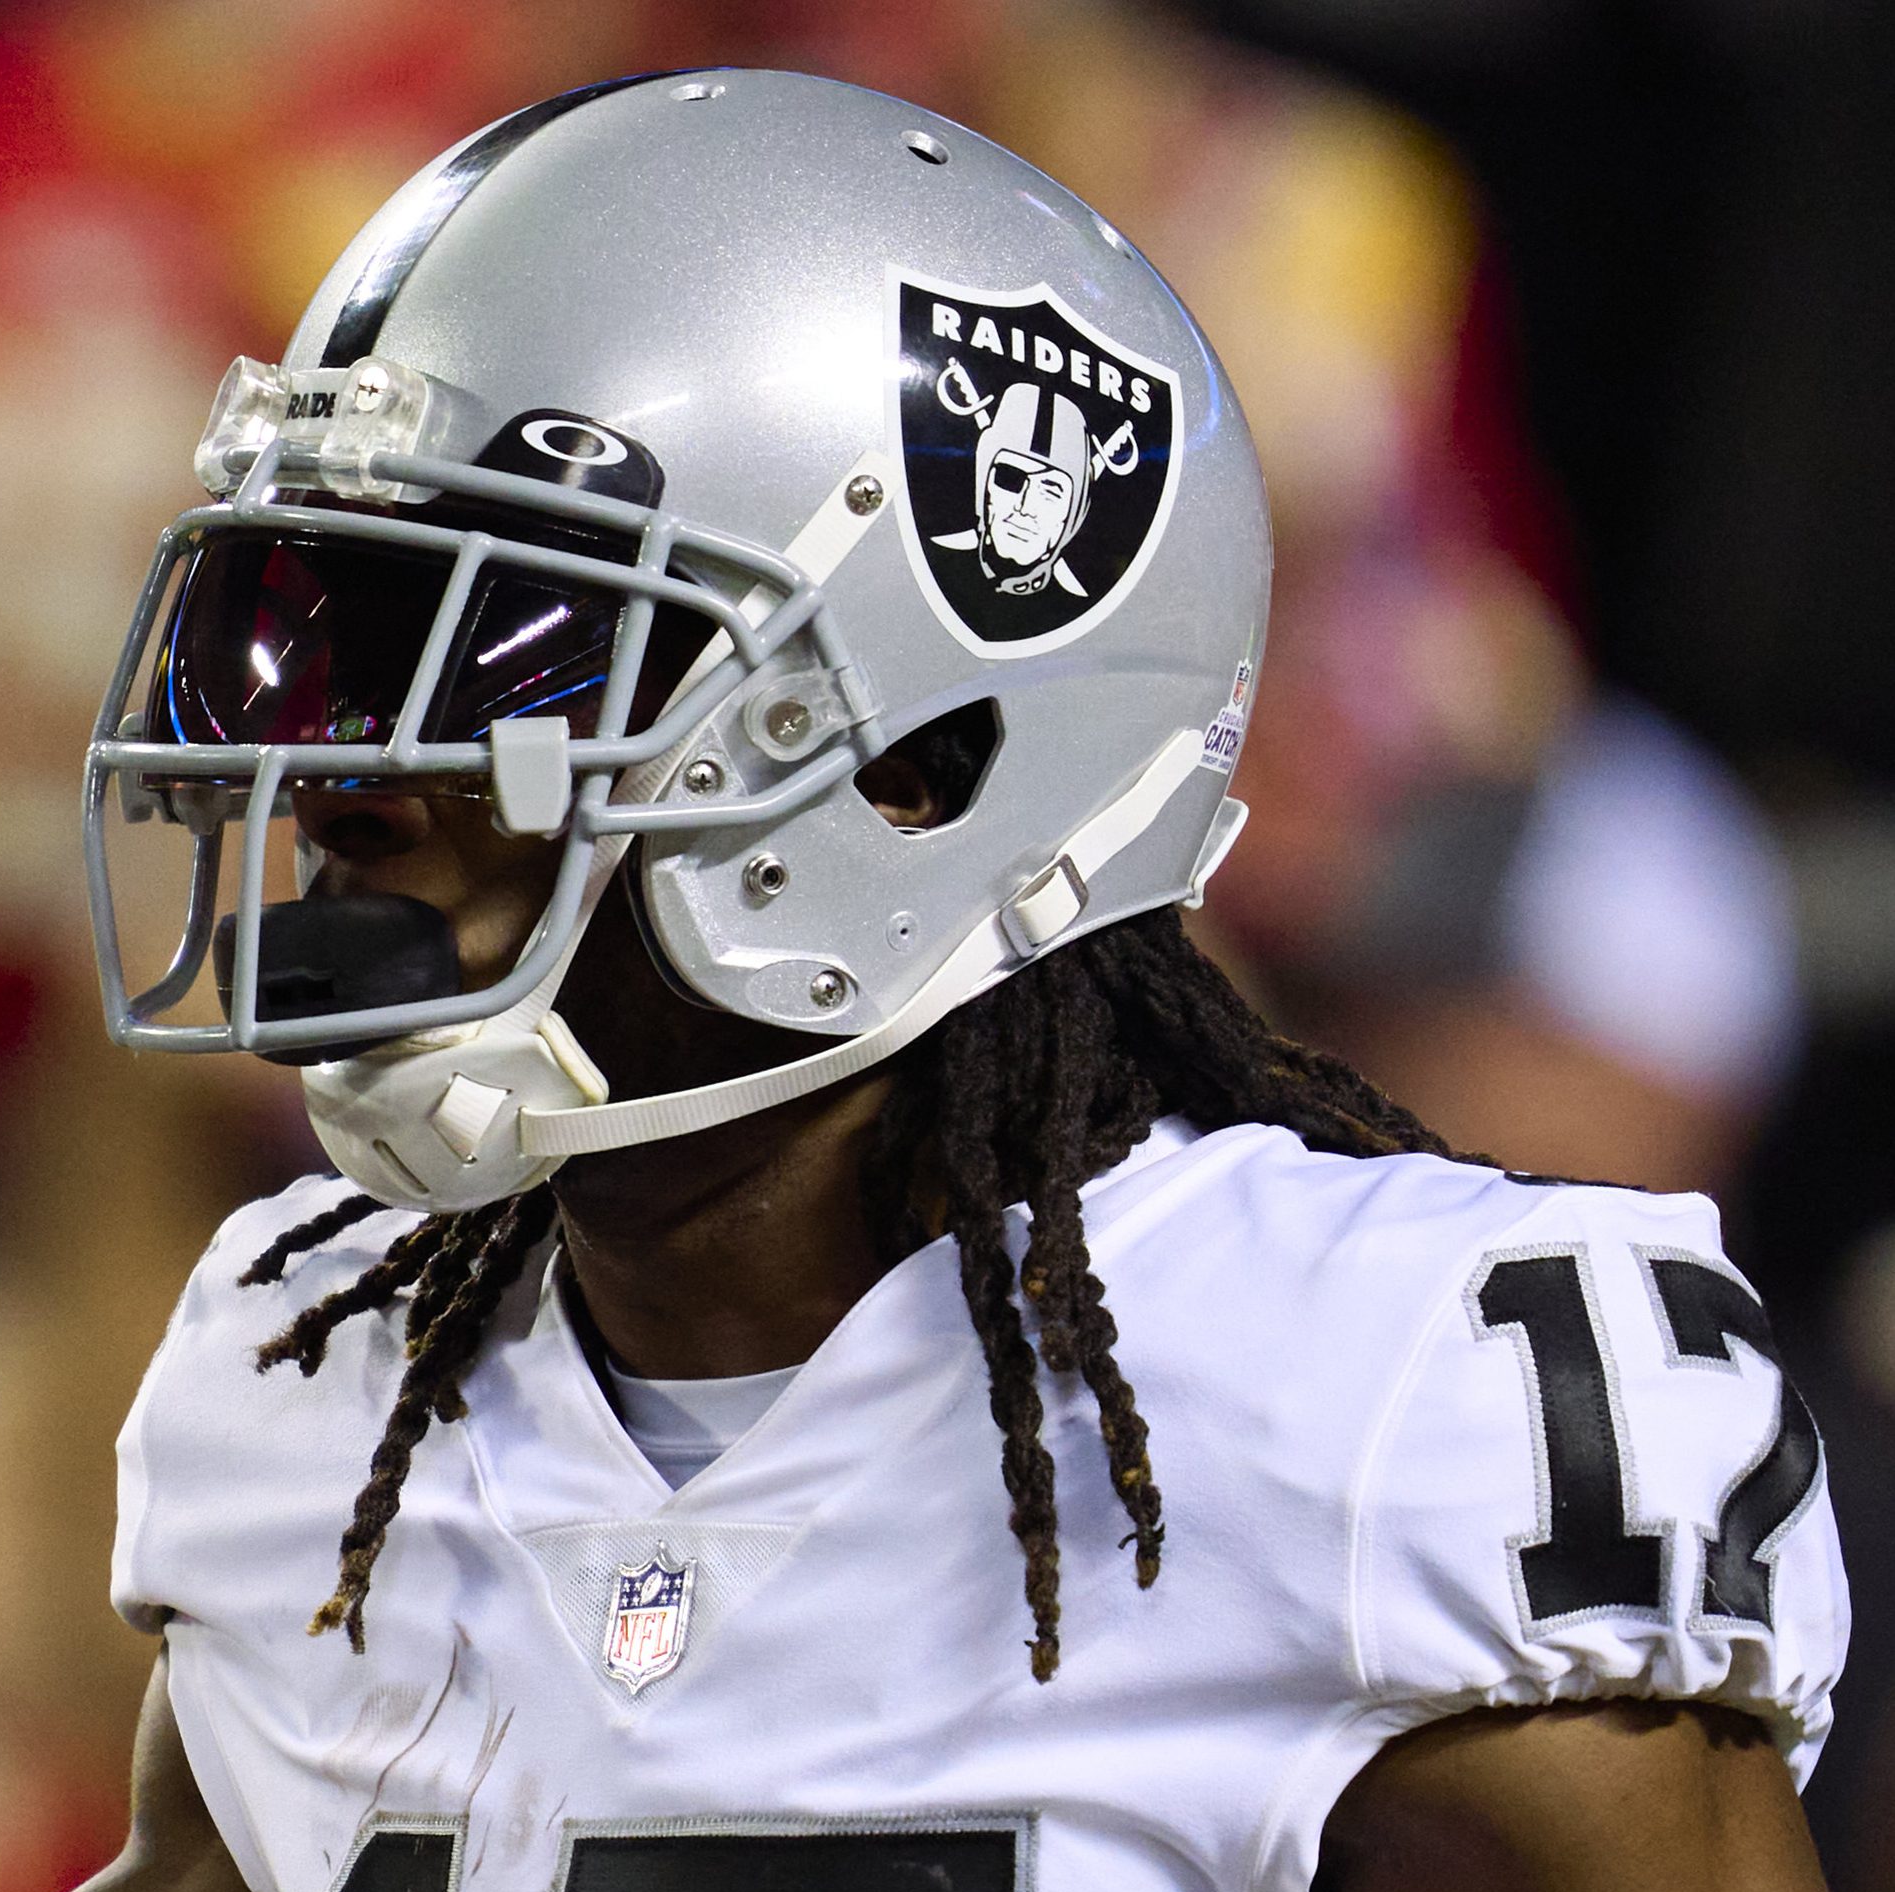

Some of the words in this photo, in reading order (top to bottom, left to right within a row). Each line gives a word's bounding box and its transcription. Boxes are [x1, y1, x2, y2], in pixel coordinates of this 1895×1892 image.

[930, 301, 1153, 415] RAIDERS
[1462, 1242, 1824, 1640] 17
[613, 1611, 670, 1667] NFL
